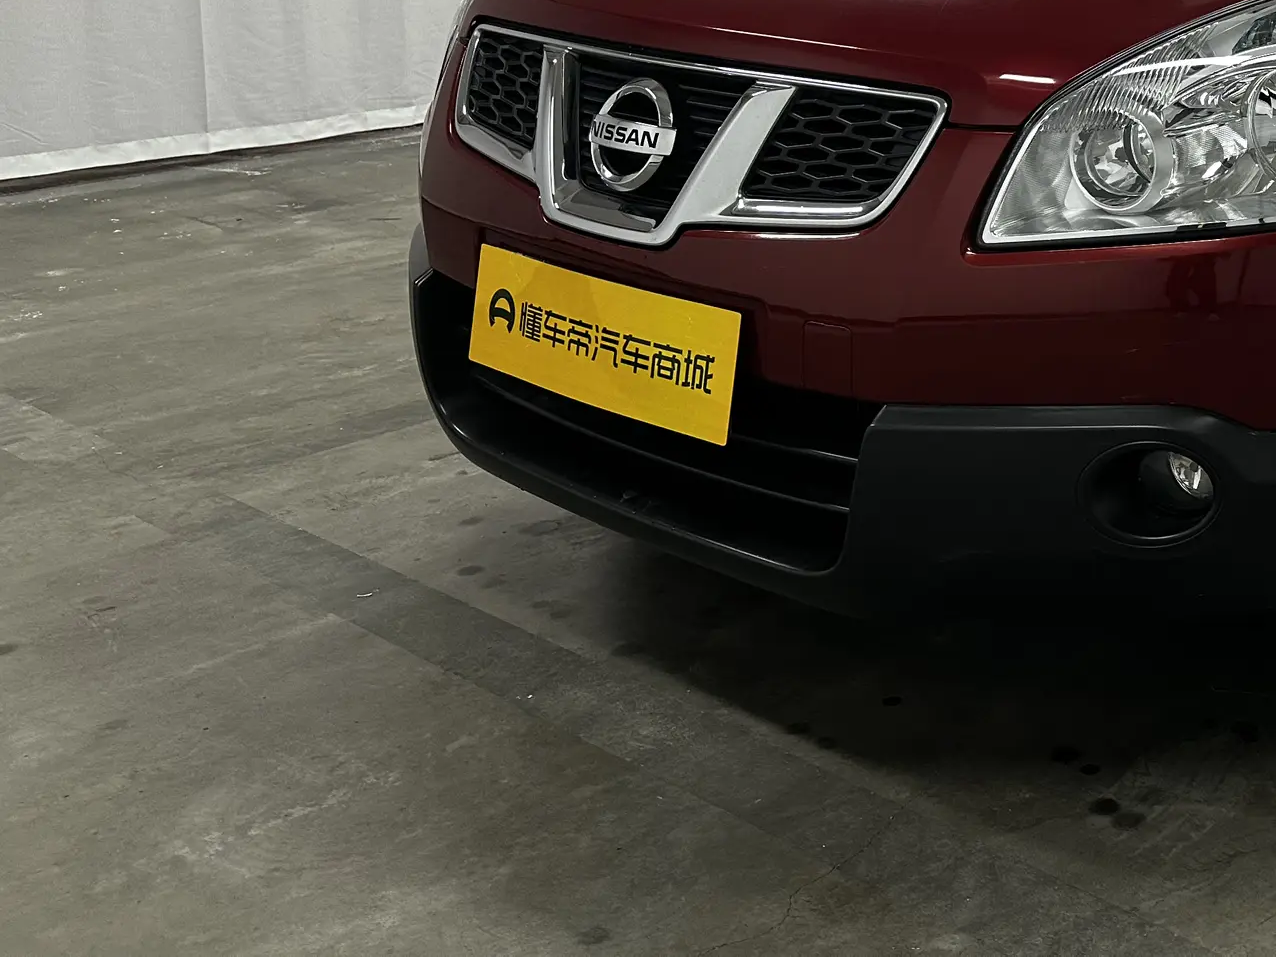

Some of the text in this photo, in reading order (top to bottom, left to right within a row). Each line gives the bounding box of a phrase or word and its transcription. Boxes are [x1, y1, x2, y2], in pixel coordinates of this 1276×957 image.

[592, 121, 660, 149] NISSAN
[519, 301, 716, 395] 懂车帝汽车商城
